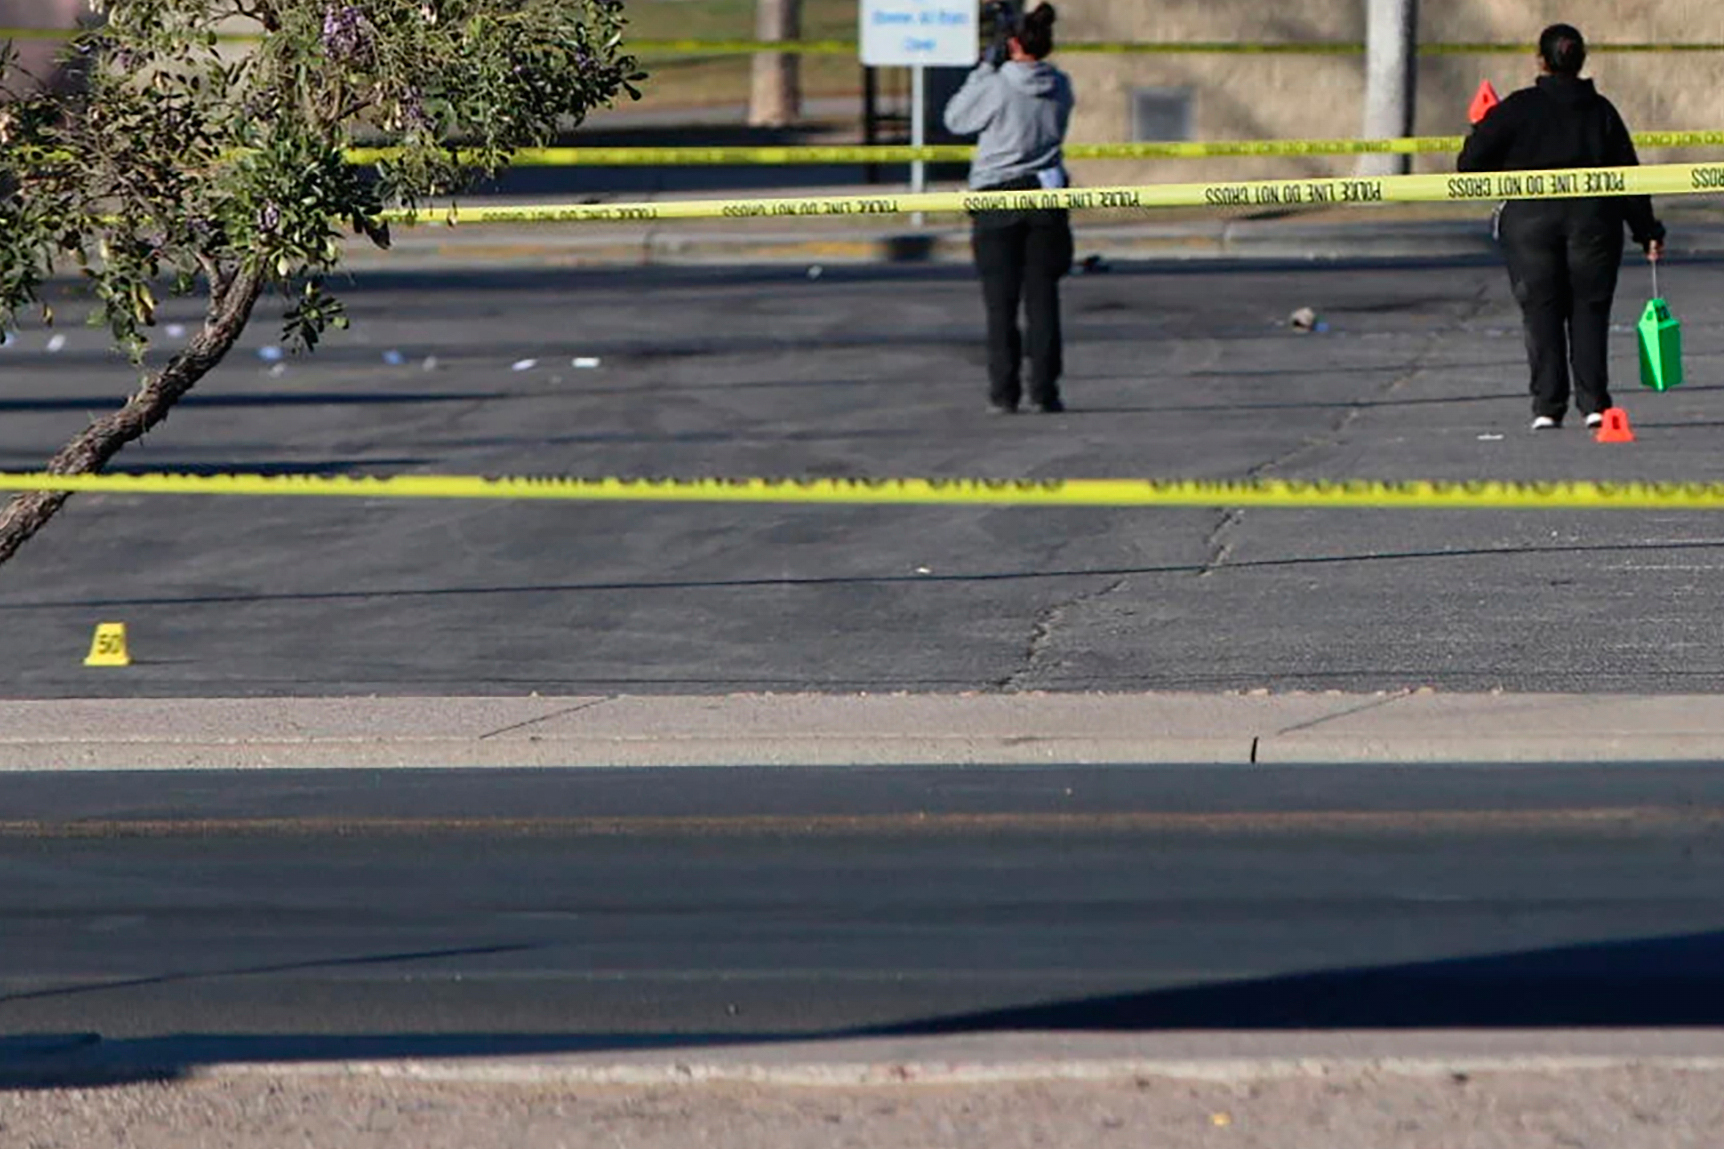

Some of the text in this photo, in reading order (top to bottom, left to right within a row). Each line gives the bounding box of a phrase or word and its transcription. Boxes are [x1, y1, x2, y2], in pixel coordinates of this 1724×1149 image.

[1204, 182, 1381, 205] POLICE LINE DO NOT CROSS
[1447, 171, 1625, 197] POLICE LINE DO NOT CROSS
[1064, 193, 1092, 208] LINE
[1098, 192, 1140, 207] POLICE
[98, 634, 122, 654] 50
